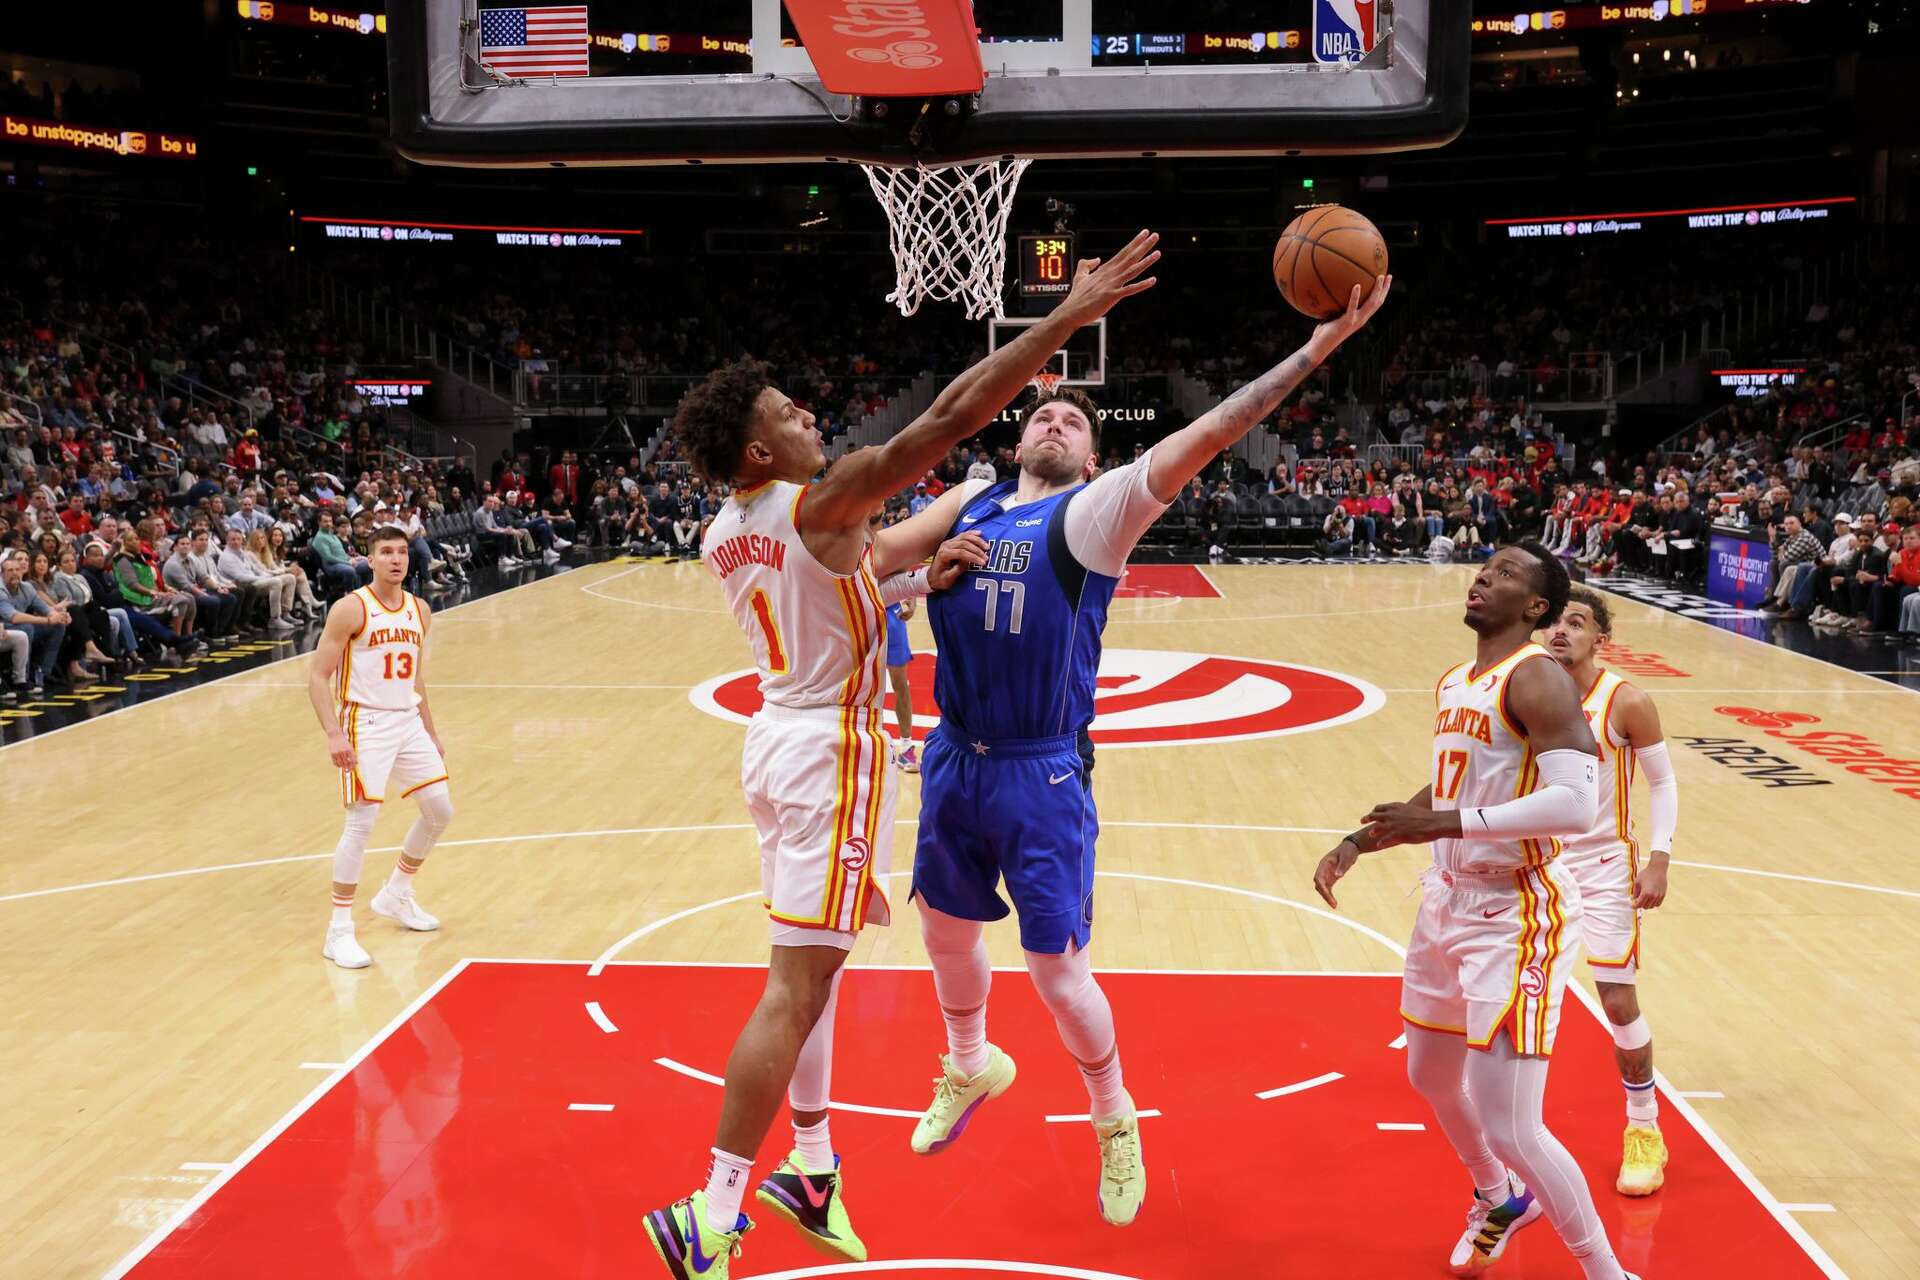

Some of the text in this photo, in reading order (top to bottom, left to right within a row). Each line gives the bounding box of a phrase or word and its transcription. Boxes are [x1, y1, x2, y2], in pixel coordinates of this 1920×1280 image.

[309, 8, 329, 23] be
[829, 0, 931, 38] Sta
[1602, 6, 1620, 19] be
[702, 36, 720, 49] be
[1106, 36, 1129, 54] 25
[1204, 34, 1222, 47] be
[1322, 32, 1352, 55] NBA
[6, 117, 28, 136] be
[161, 136, 182, 153] be
[1688, 215, 1723, 228] WATCH
[1760, 210, 1776, 223] ON
[326, 225, 360, 237] WATCH
[361, 227, 380, 239] THE
[394, 229, 408, 240] ON
[1508, 225, 1542, 237] WATCH
[1543, 224, 1562, 236] THE
[1577, 222, 1592, 234] ON
[496, 233, 529, 244] WATCH
[530, 234, 549, 245] THE
[563, 235, 577, 246] ON
[1036, 240, 1066, 255] 3:34
[1040, 256, 1062, 279] 10
[1036, 284, 1070, 292] TISSOT
[1720, 374, 1795, 386] WATCH THE ON
[383, 385, 399, 395] THE
[411, 385, 423, 395] ON
[712, 534, 787, 579] JOHNSON
[1728, 554, 1742, 569] ONLY
[1742, 557, 1762, 572] WORTH
[1762, 561, 1768, 573] IT
[1721, 565, 1763, 585] IF YOU ENJOY IT
[975, 578, 1025, 634] 77
[368, 627, 422, 649] ATLANTA
[750, 587, 789, 675] 1
[383, 652, 413, 680] 13
[1671, 735, 1834, 788] ARENA
[1434, 749, 1471, 800] 17
